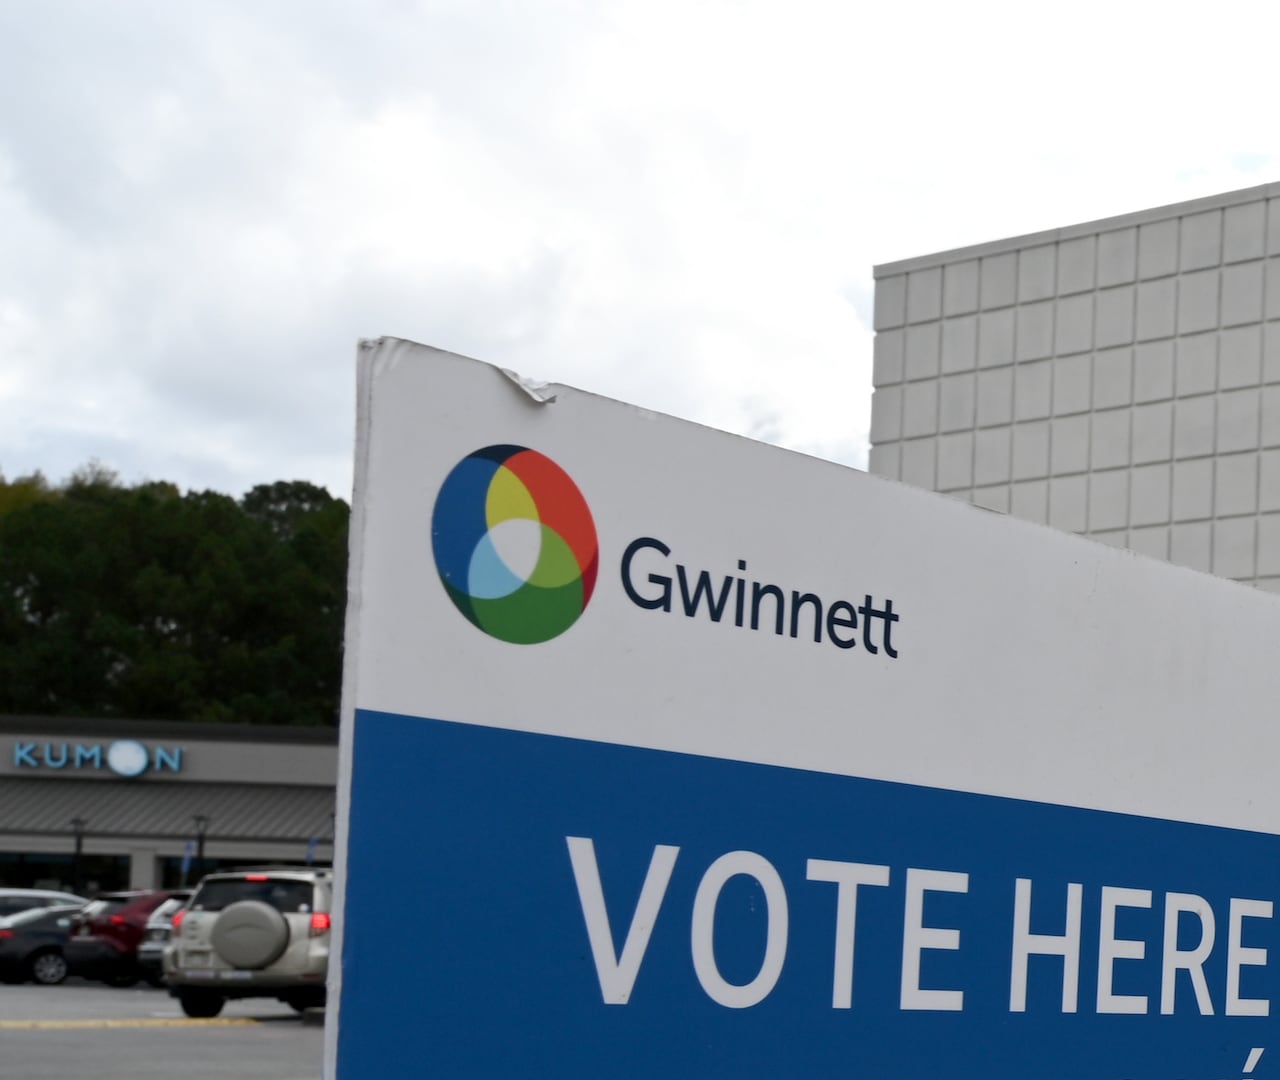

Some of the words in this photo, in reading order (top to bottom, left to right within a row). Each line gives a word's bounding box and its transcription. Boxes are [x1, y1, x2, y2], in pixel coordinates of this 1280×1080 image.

[621, 537, 899, 658] Gwinnett
[14, 739, 183, 777] KUMON
[566, 837, 968, 1010] VOTE
[1010, 878, 1273, 1016] HERE
